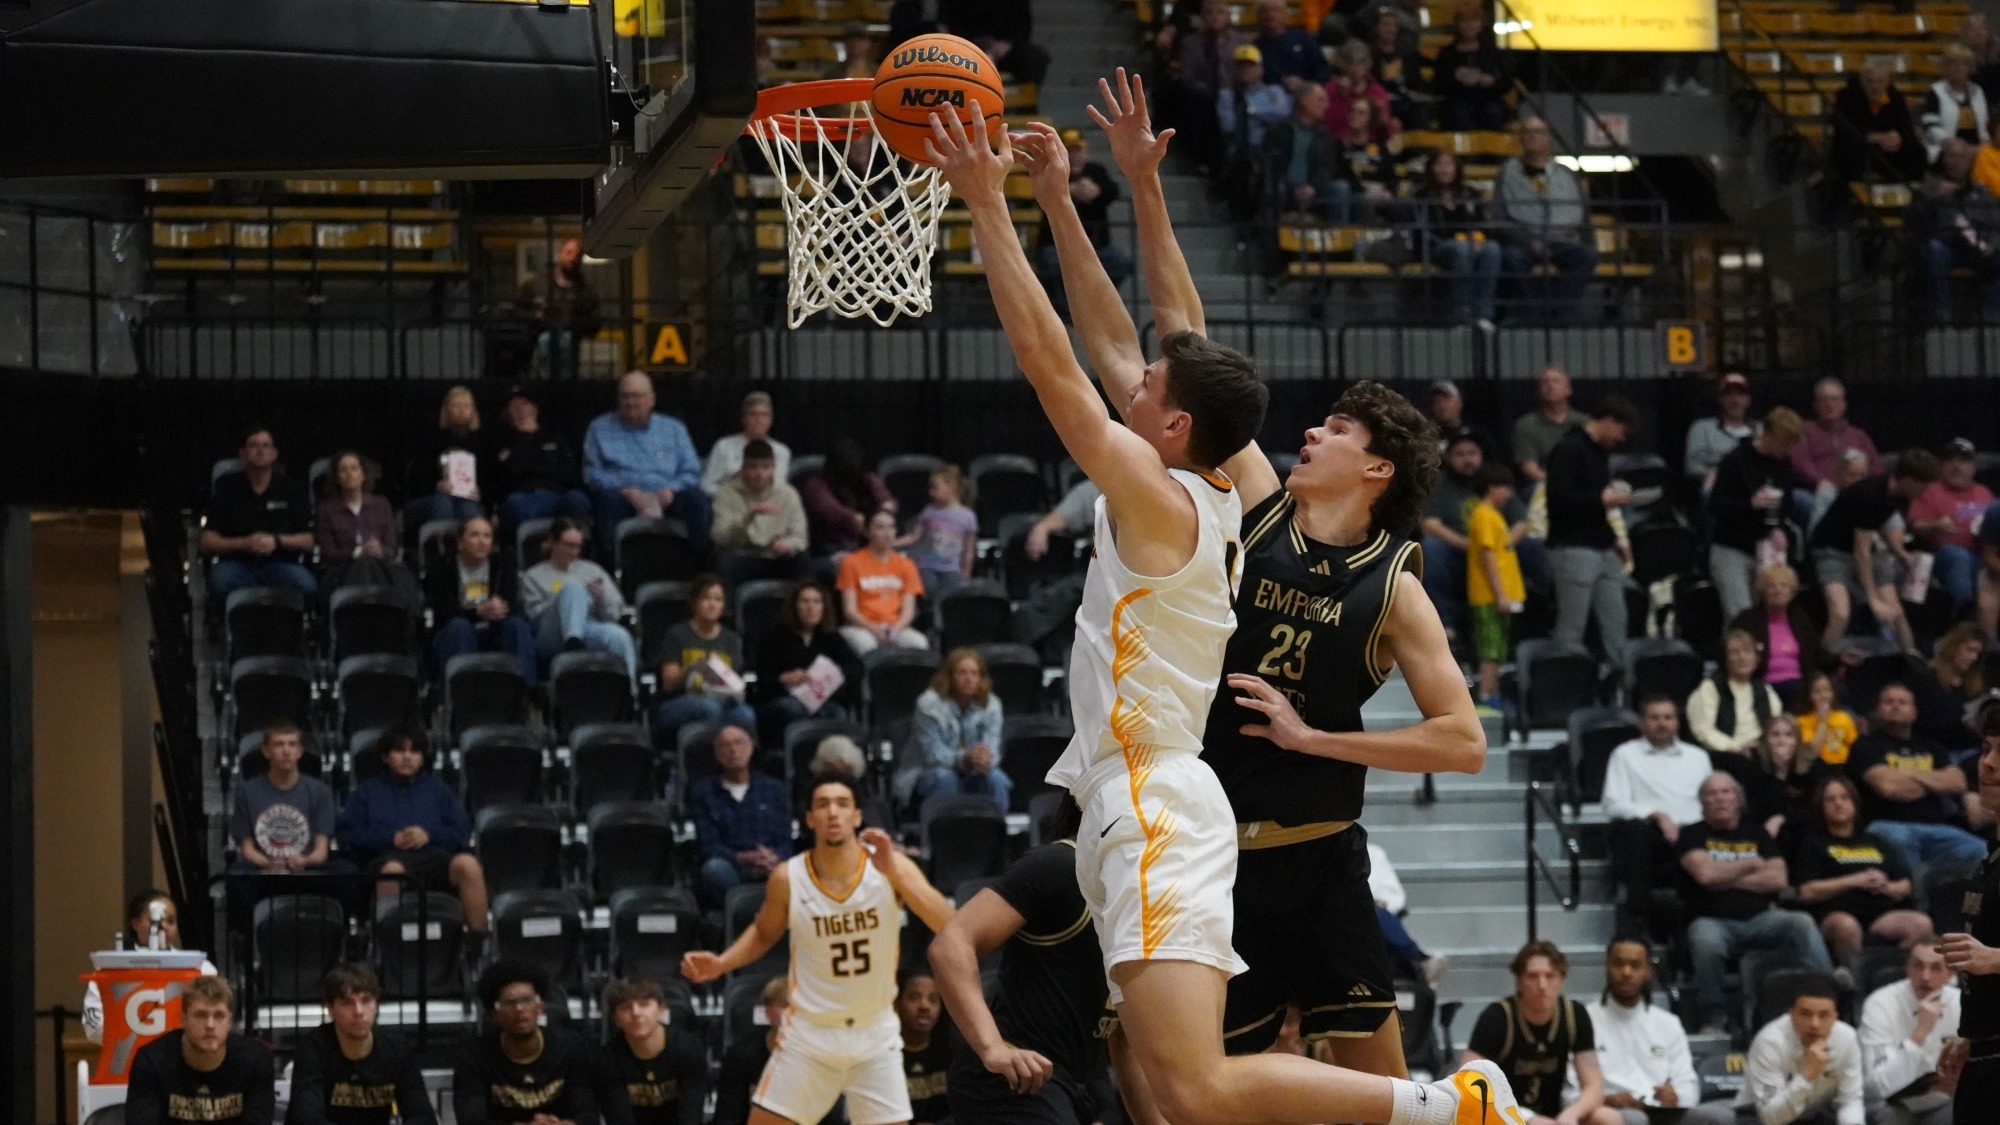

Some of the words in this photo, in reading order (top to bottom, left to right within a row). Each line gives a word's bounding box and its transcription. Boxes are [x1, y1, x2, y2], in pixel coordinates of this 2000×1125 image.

[893, 46, 979, 75] Wilson
[901, 88, 965, 108] NCAA
[651, 324, 687, 364] A
[1667, 327, 1696, 364] B
[1254, 578, 1343, 627] EMPORIA
[1257, 624, 1312, 680] 23
[811, 907, 879, 937] TIGERS
[830, 939, 870, 977] 25
[125, 988, 166, 1036] G
